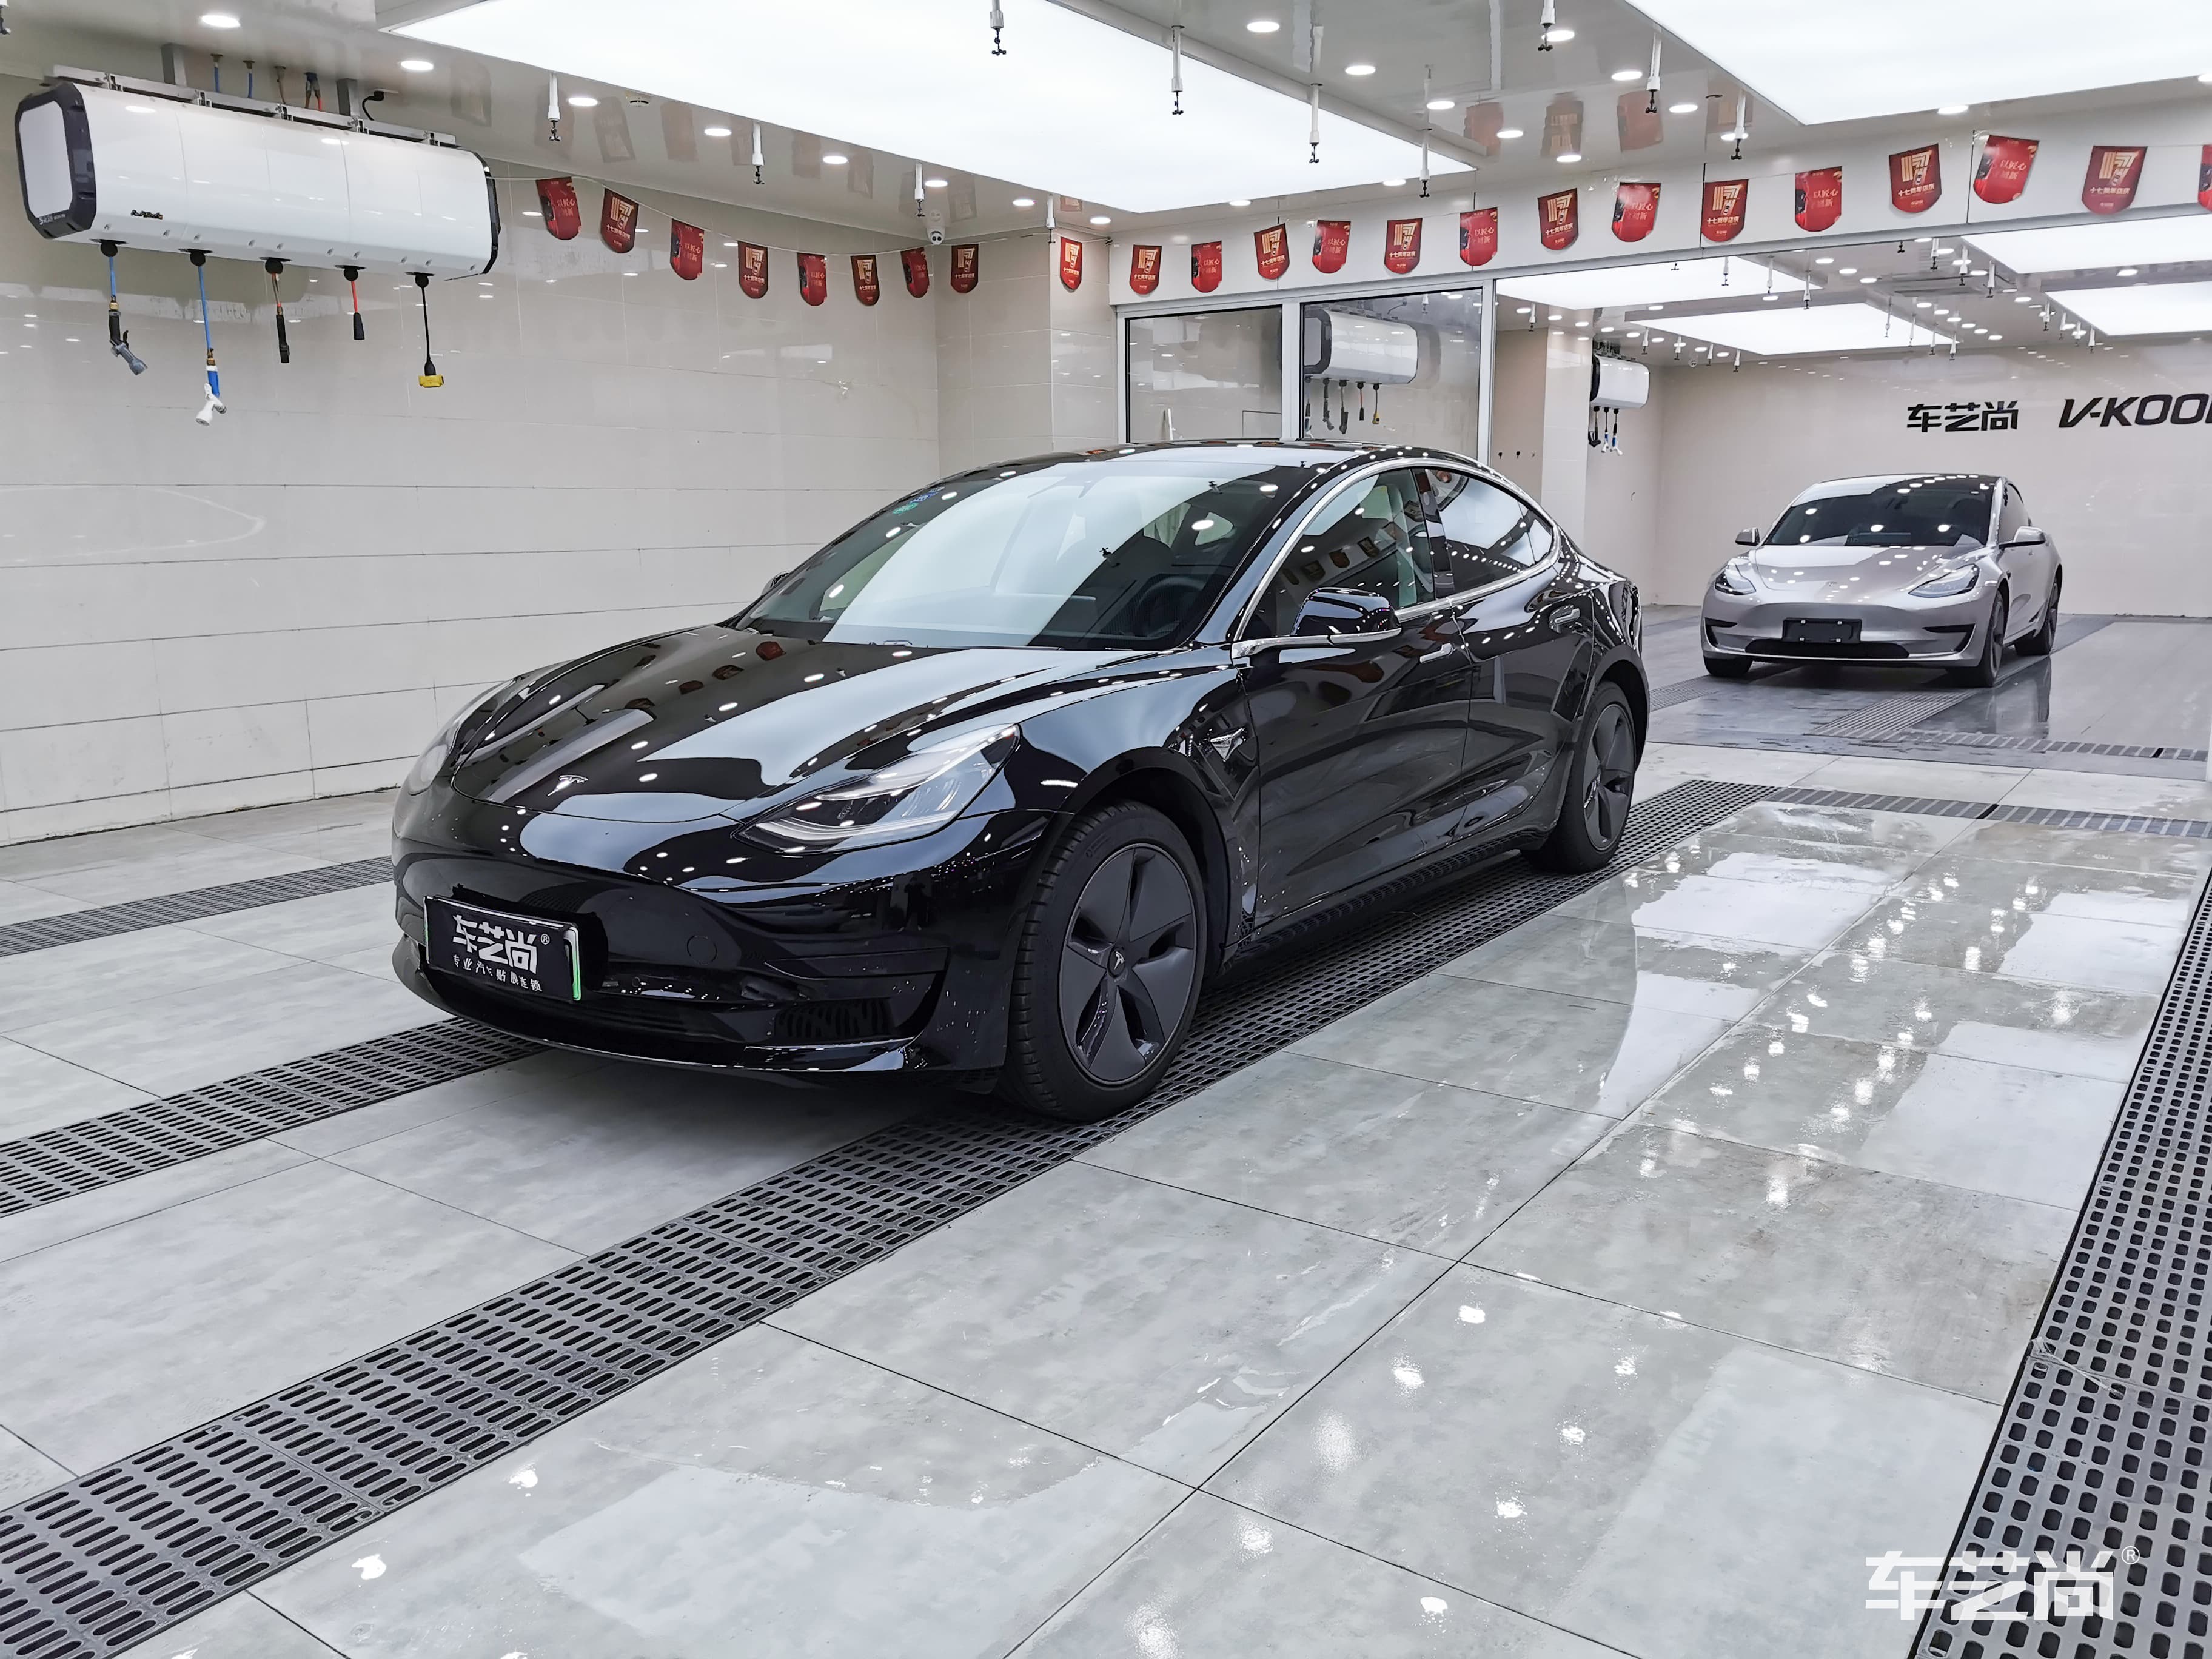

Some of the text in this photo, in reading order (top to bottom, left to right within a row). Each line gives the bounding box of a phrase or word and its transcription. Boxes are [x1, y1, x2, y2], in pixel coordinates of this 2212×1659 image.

[1906, 400, 2019, 433] 车艺尚
[2058, 393, 2212, 428] V-KOO
[452, 914, 537, 974] 车艺尚
